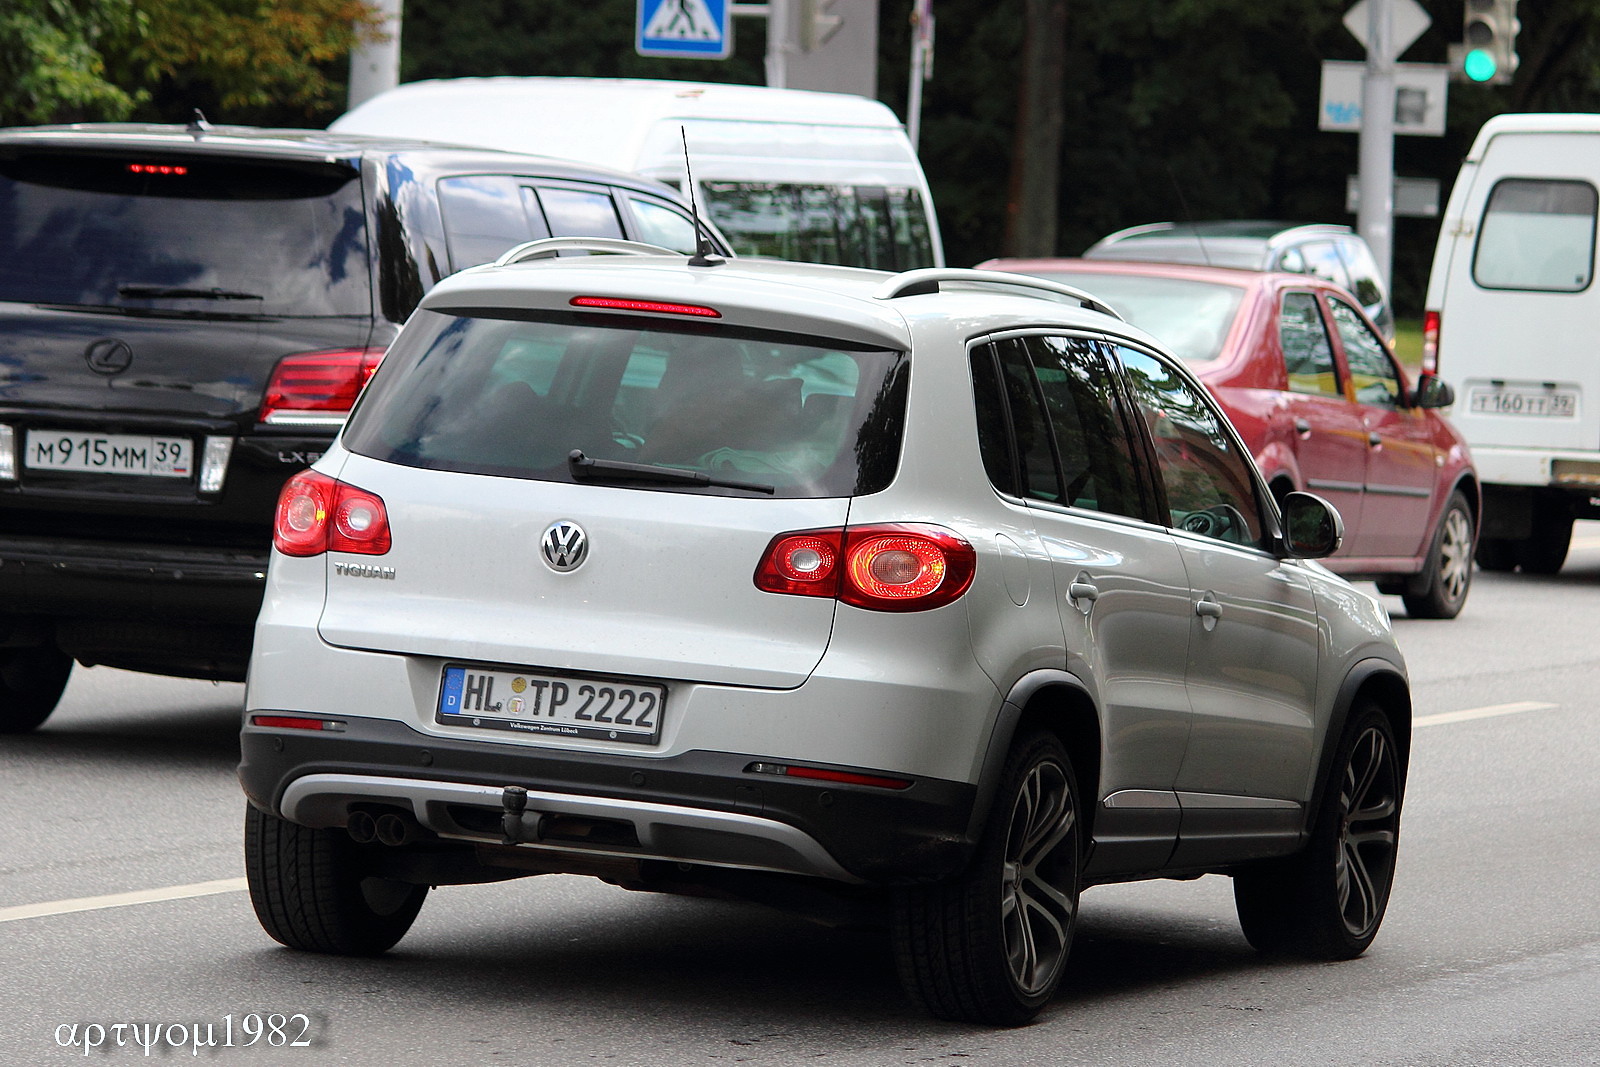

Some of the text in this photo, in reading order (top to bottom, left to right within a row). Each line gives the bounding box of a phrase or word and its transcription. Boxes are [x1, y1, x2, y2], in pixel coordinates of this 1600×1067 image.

[156, 441, 182, 464] 39
[334, 561, 396, 580] TIGUAN
[531, 679, 570, 717] TP
[574, 685, 657, 728] 2222
[509, 722, 579, 735] Volkswagen Zentrum Lübeck
